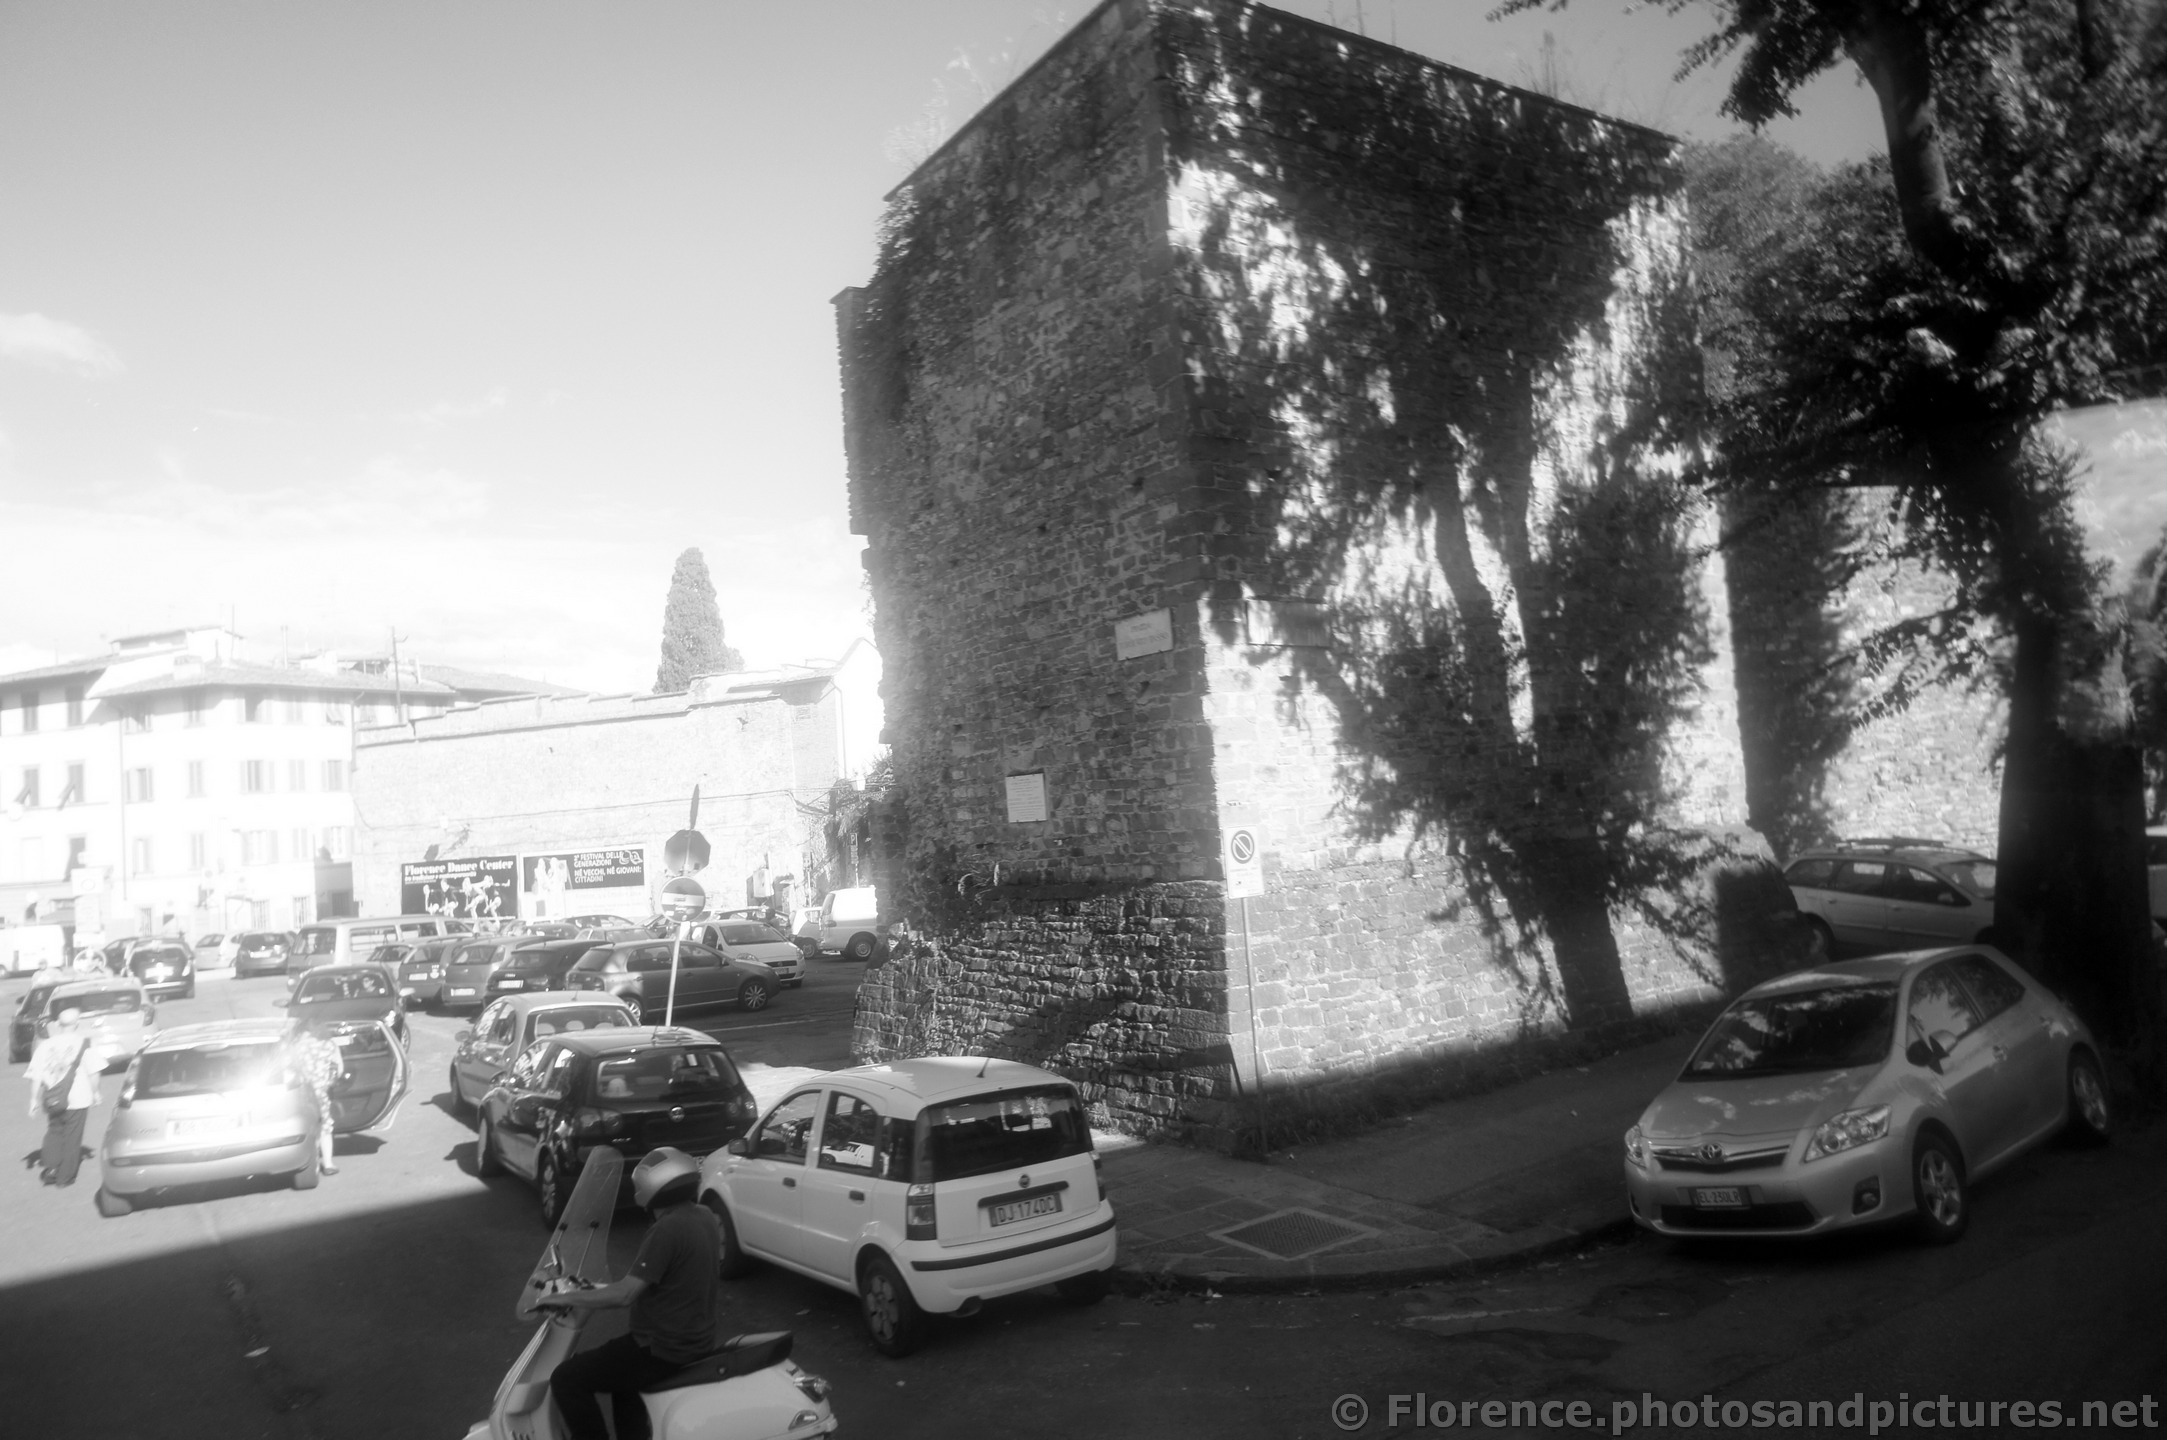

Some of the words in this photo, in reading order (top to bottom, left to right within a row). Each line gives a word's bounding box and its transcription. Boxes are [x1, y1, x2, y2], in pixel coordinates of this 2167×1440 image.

[404, 864, 446, 876] Florence
[447, 862, 478, 873] Dance
[479, 859, 514, 870] Center
[573, 859, 612, 868] GENERAZIONI
[616, 866, 642, 875] GIOVANI:
[574, 876, 604, 884] CITTADINI
